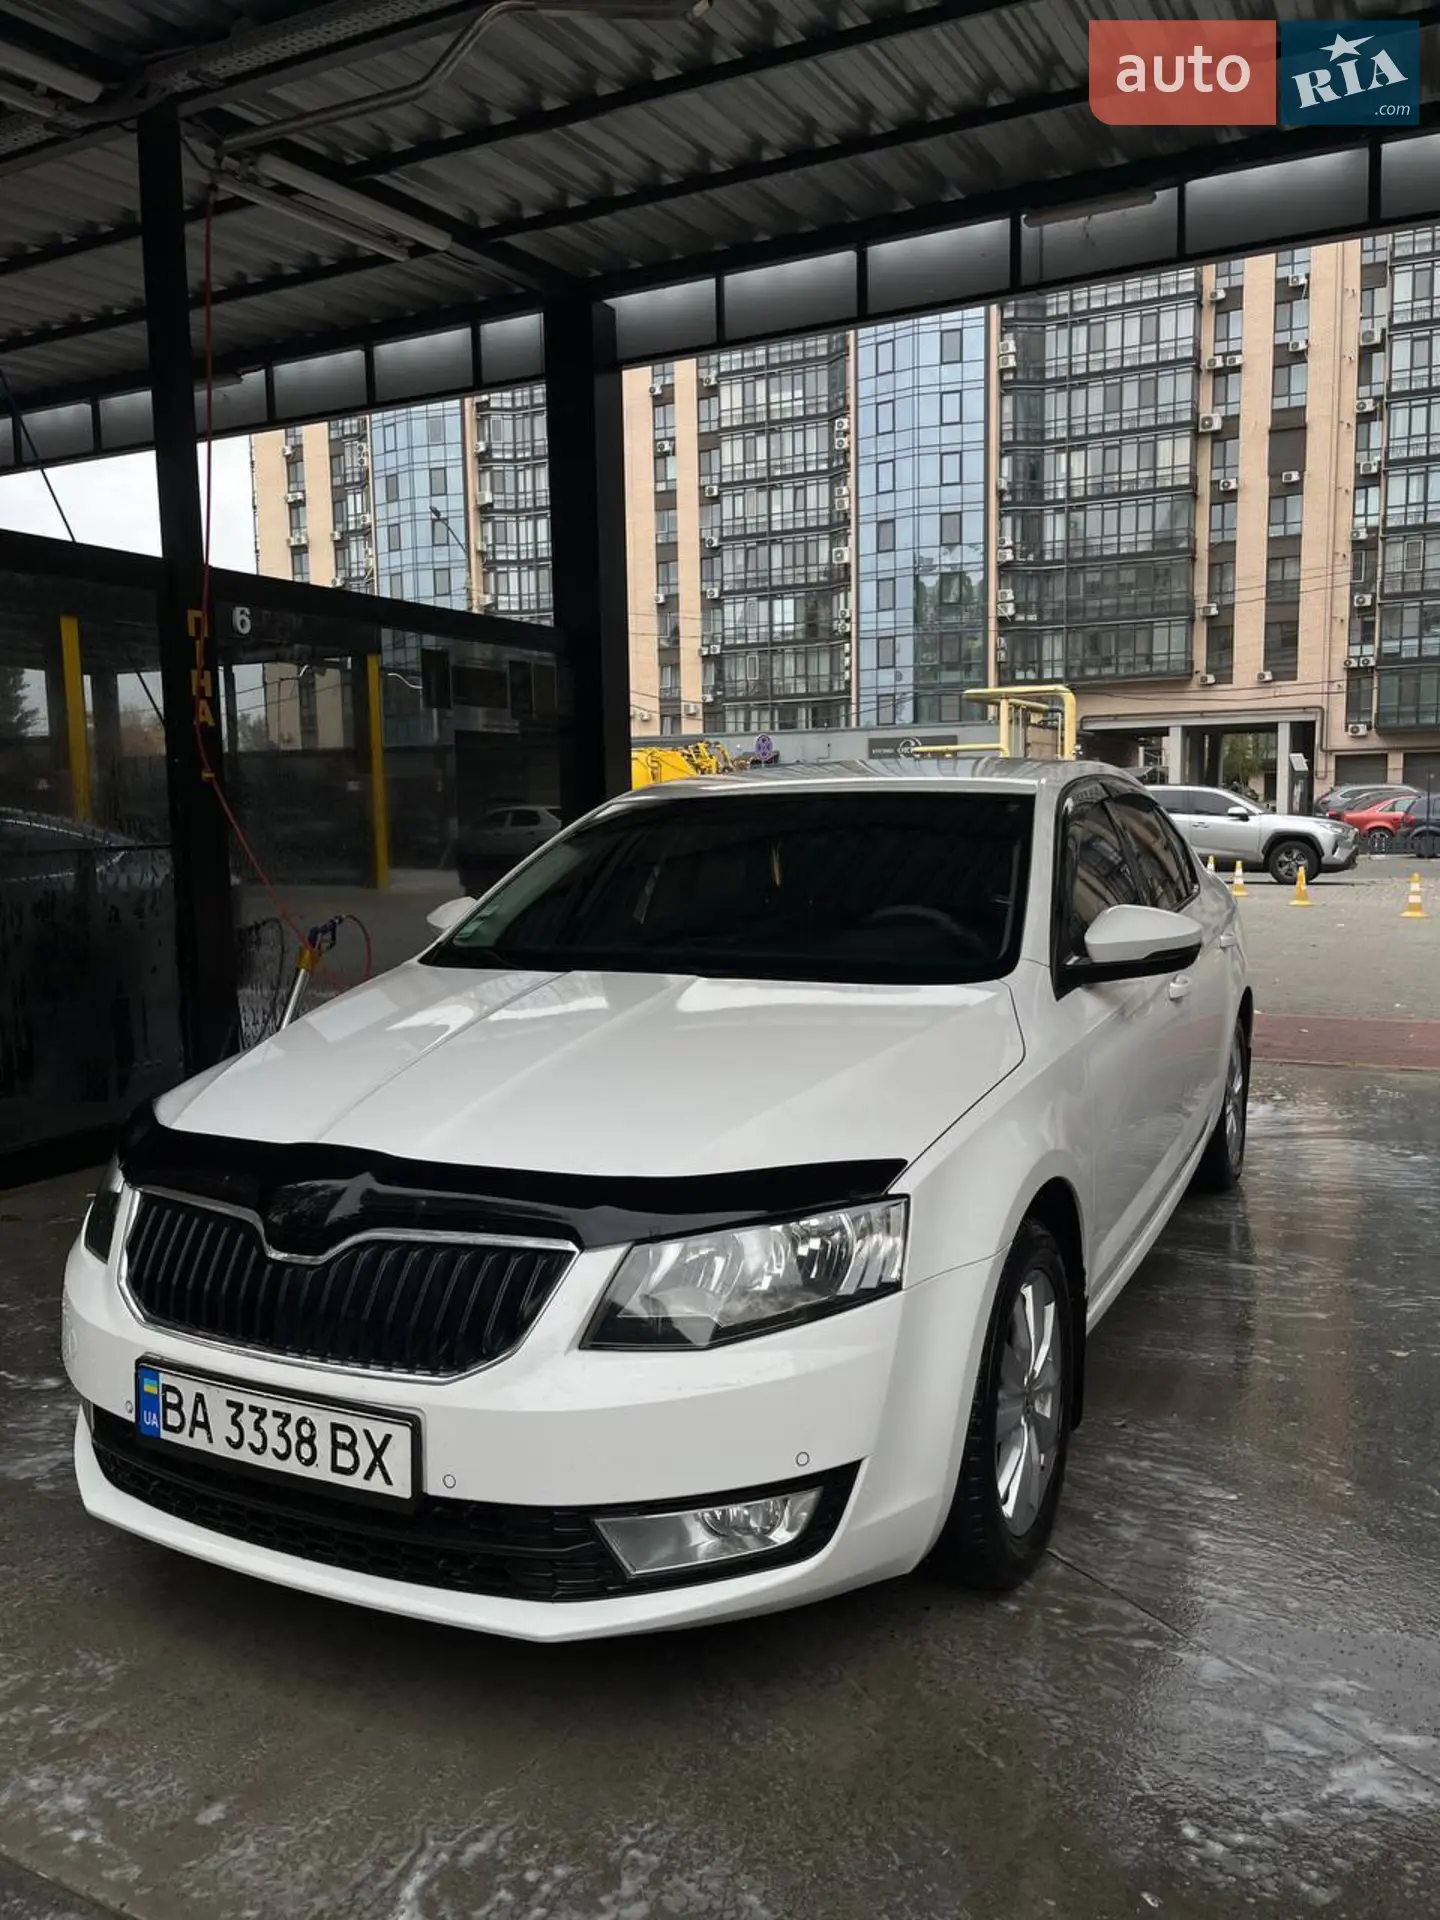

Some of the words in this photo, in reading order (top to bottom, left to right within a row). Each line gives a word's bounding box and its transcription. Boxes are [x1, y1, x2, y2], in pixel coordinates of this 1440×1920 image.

[232, 606, 251, 635] 6
[144, 1411, 159, 1428] UA
[162, 1384, 214, 1444] BA
[225, 1399, 317, 1467] 3338
[331, 1422, 394, 1486] BX
